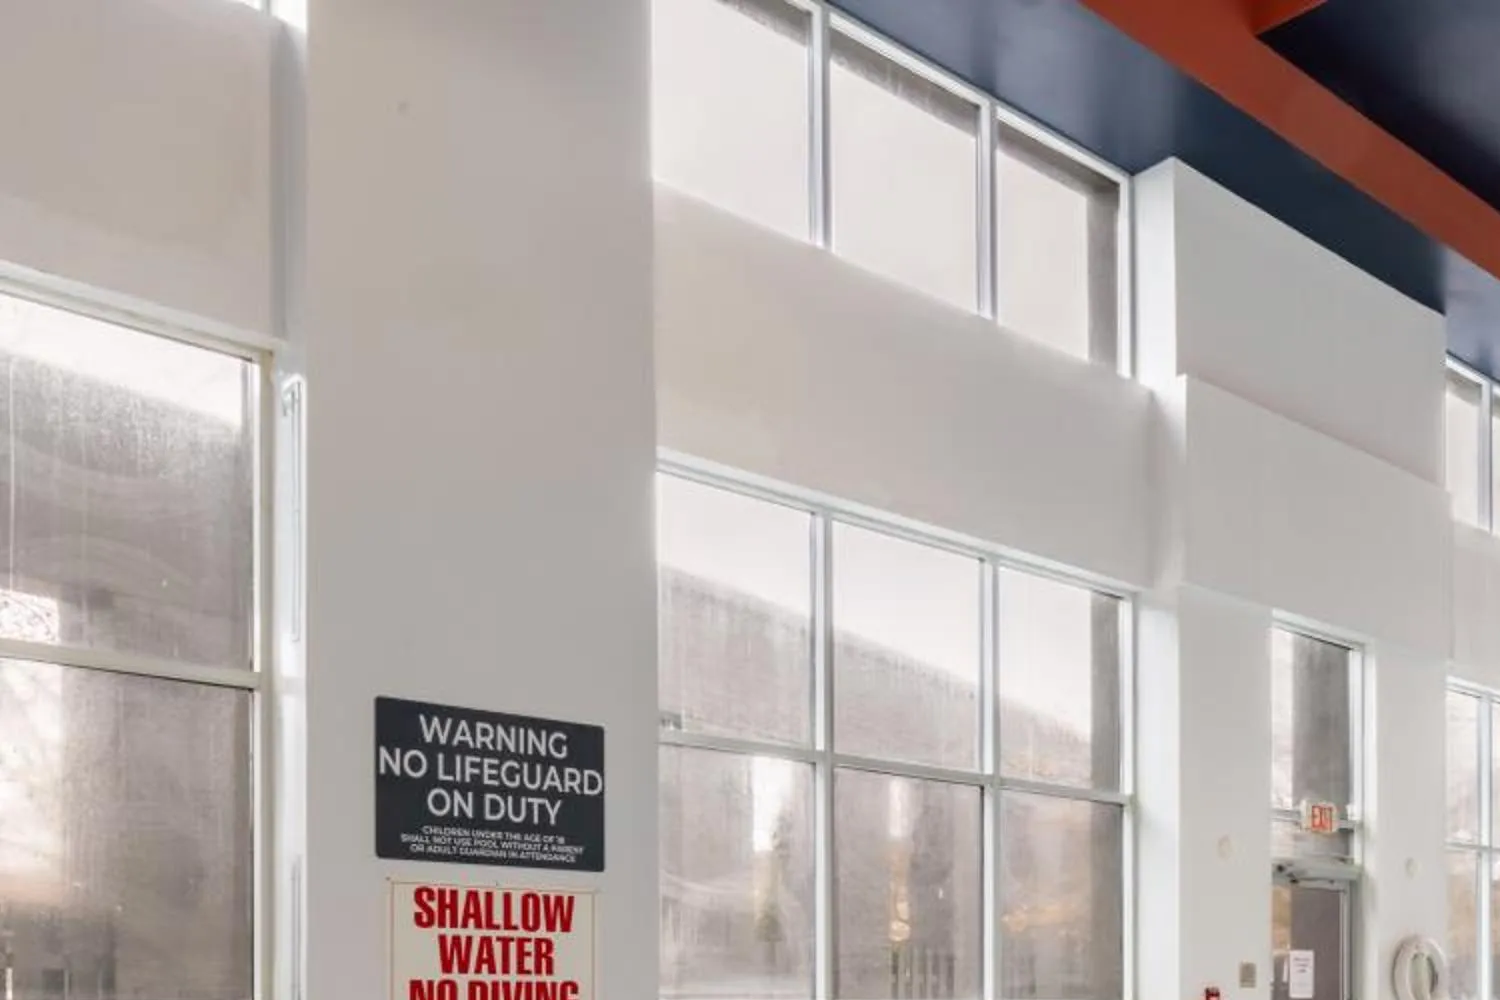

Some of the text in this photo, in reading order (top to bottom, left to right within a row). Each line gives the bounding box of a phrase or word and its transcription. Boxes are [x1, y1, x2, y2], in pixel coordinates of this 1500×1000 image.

[419, 713, 568, 759] WARNING
[379, 746, 603, 796] NO LIFEGUARD
[427, 788, 563, 825] ON DUTY
[474, 838, 498, 849] POOL
[501, 840, 541, 851] WITHOUT
[505, 831, 522, 841] THE
[413, 886, 575, 933] SHALLOW
[438, 934, 555, 976] WATER
